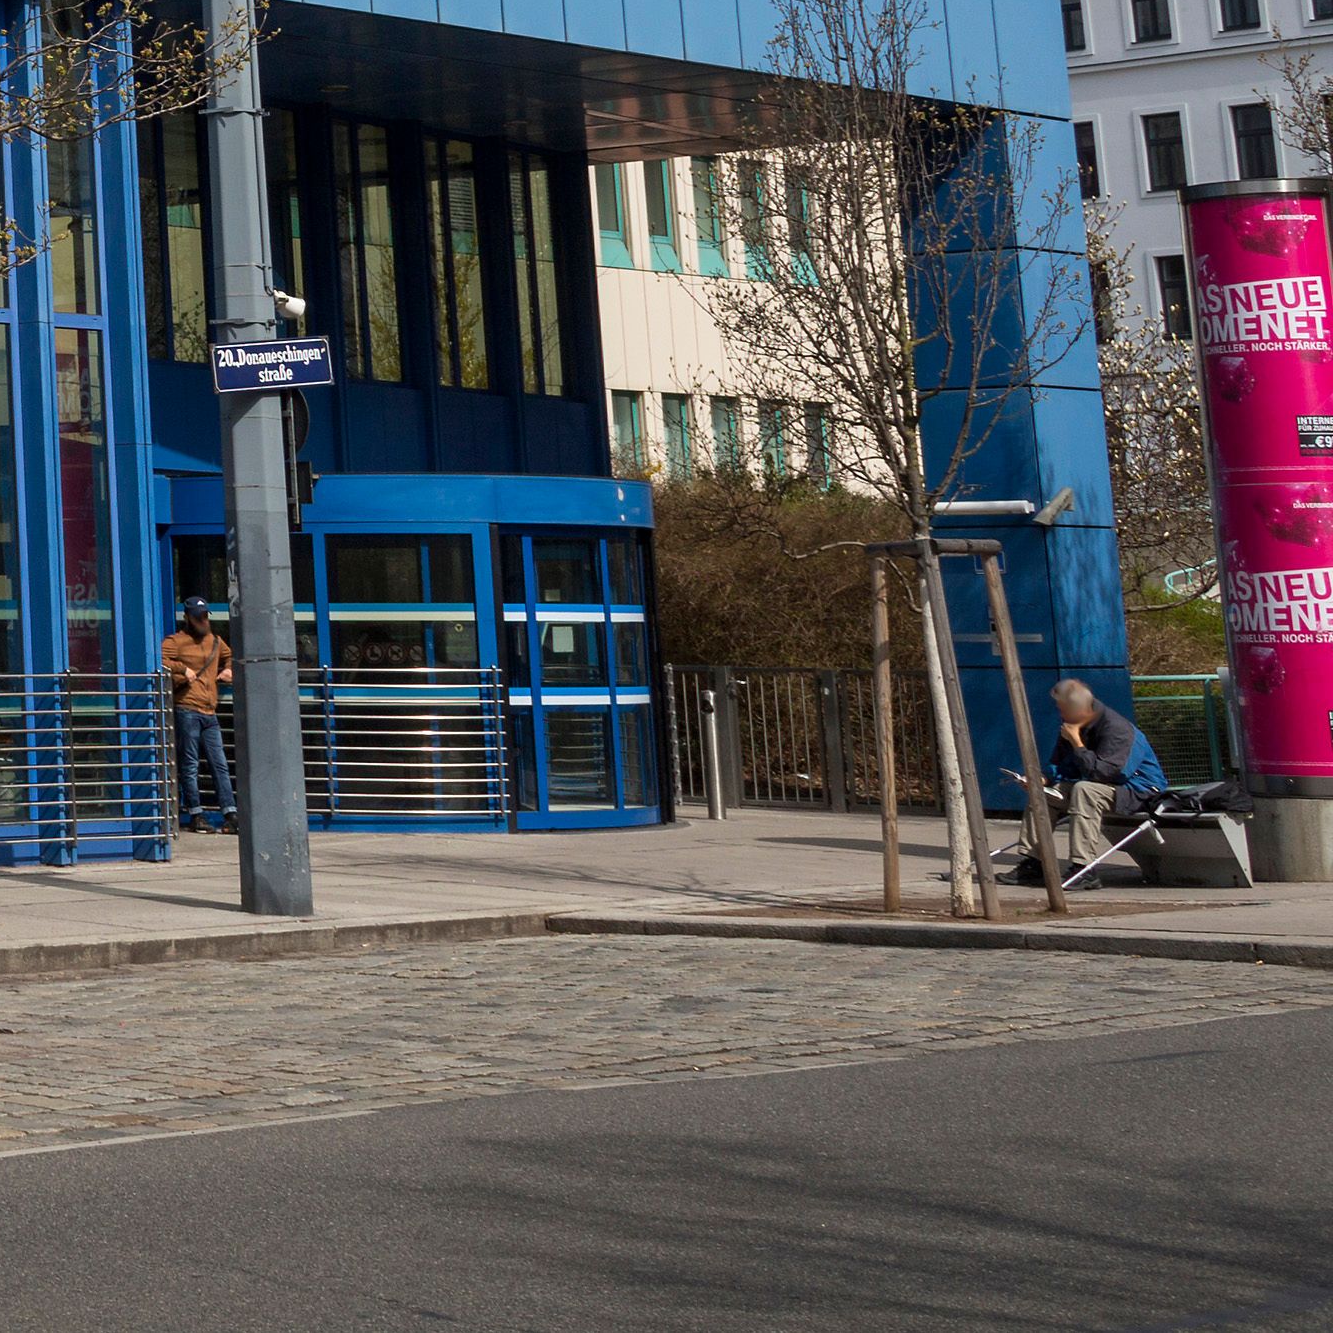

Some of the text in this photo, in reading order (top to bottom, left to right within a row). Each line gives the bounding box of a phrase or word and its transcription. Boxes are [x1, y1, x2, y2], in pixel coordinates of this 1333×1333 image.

[1228, 279, 1322, 313] NEUE
[1204, 340, 1331, 354] CHNELLER. NOCH STÄRKER.
[258, 364, 293, 383] straße
[1234, 633, 1280, 643] CHNELLER.
[1281, 633, 1314, 644] NOCH
